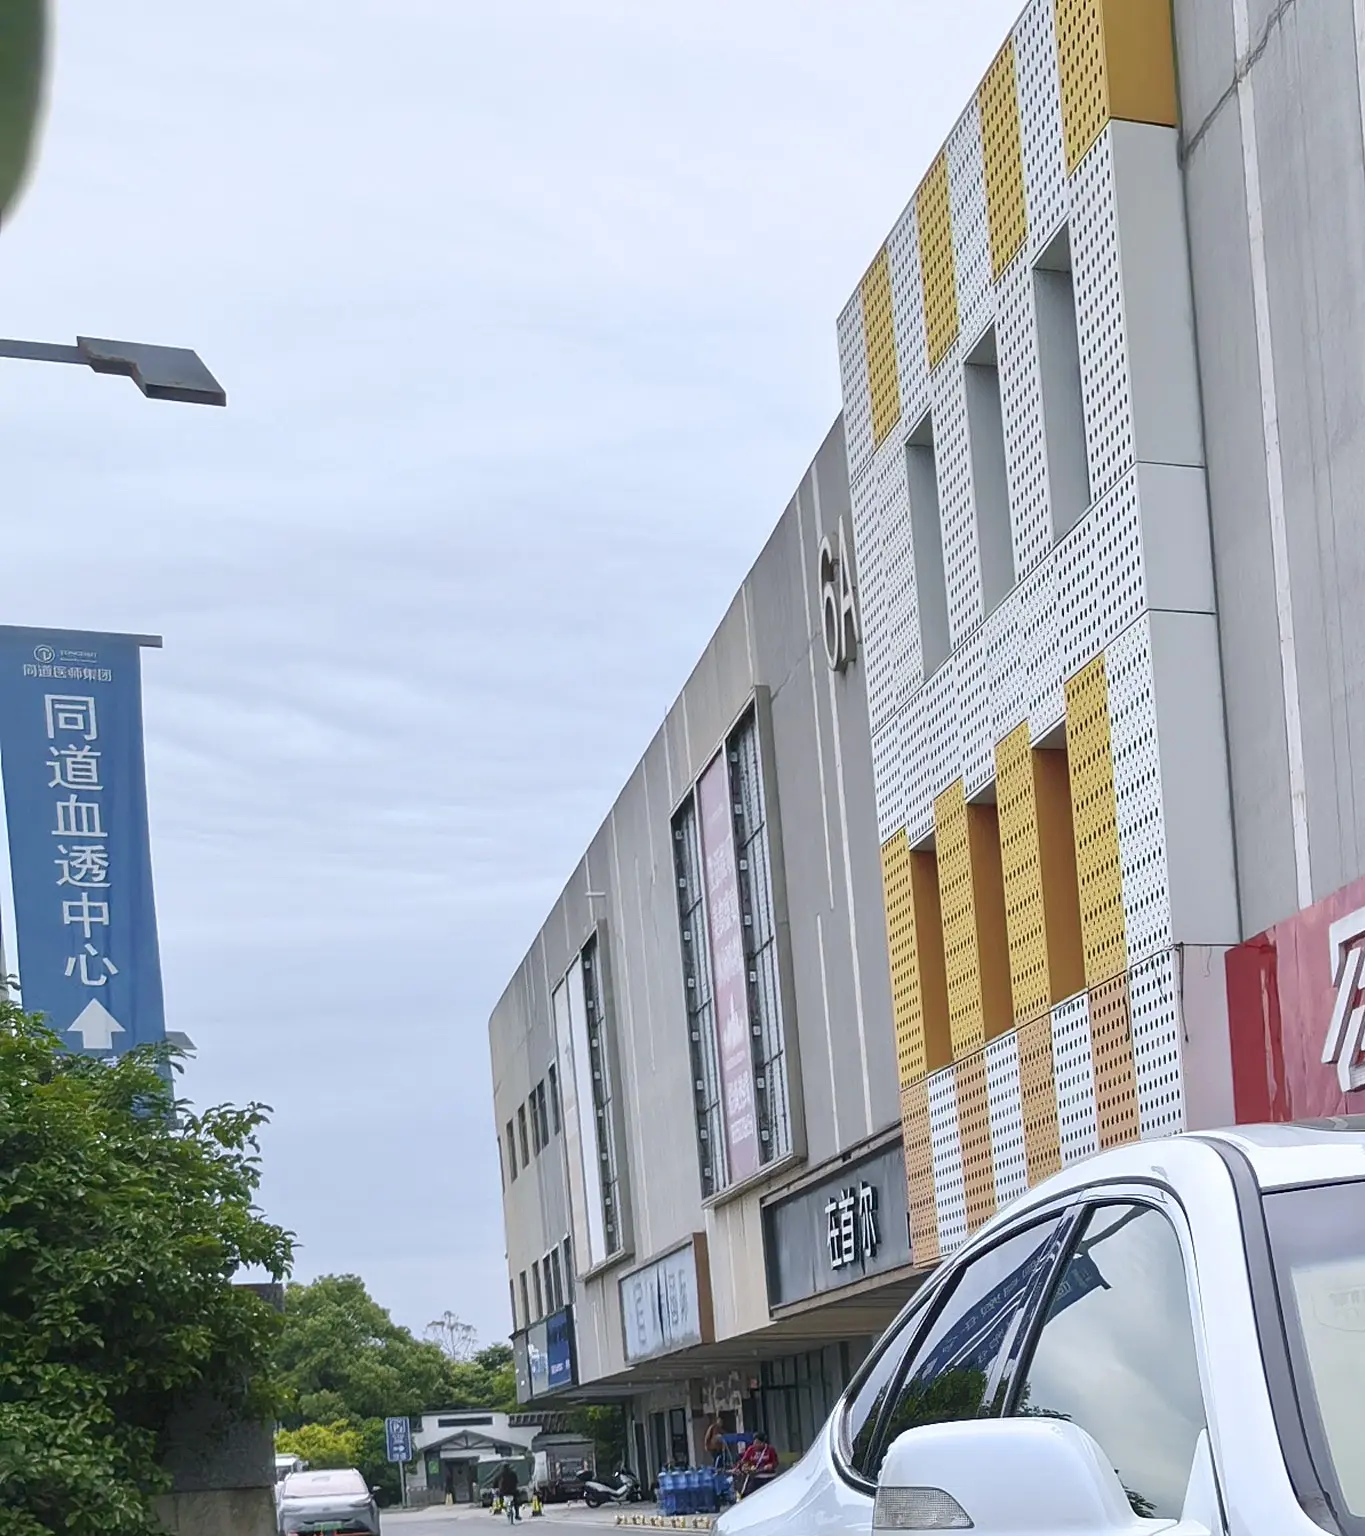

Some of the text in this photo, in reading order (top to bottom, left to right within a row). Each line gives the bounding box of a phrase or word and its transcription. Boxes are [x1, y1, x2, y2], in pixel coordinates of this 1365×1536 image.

[44, 693, 119, 987] 同道血透中心
[824, 1180, 883, 1271] 在首尔
